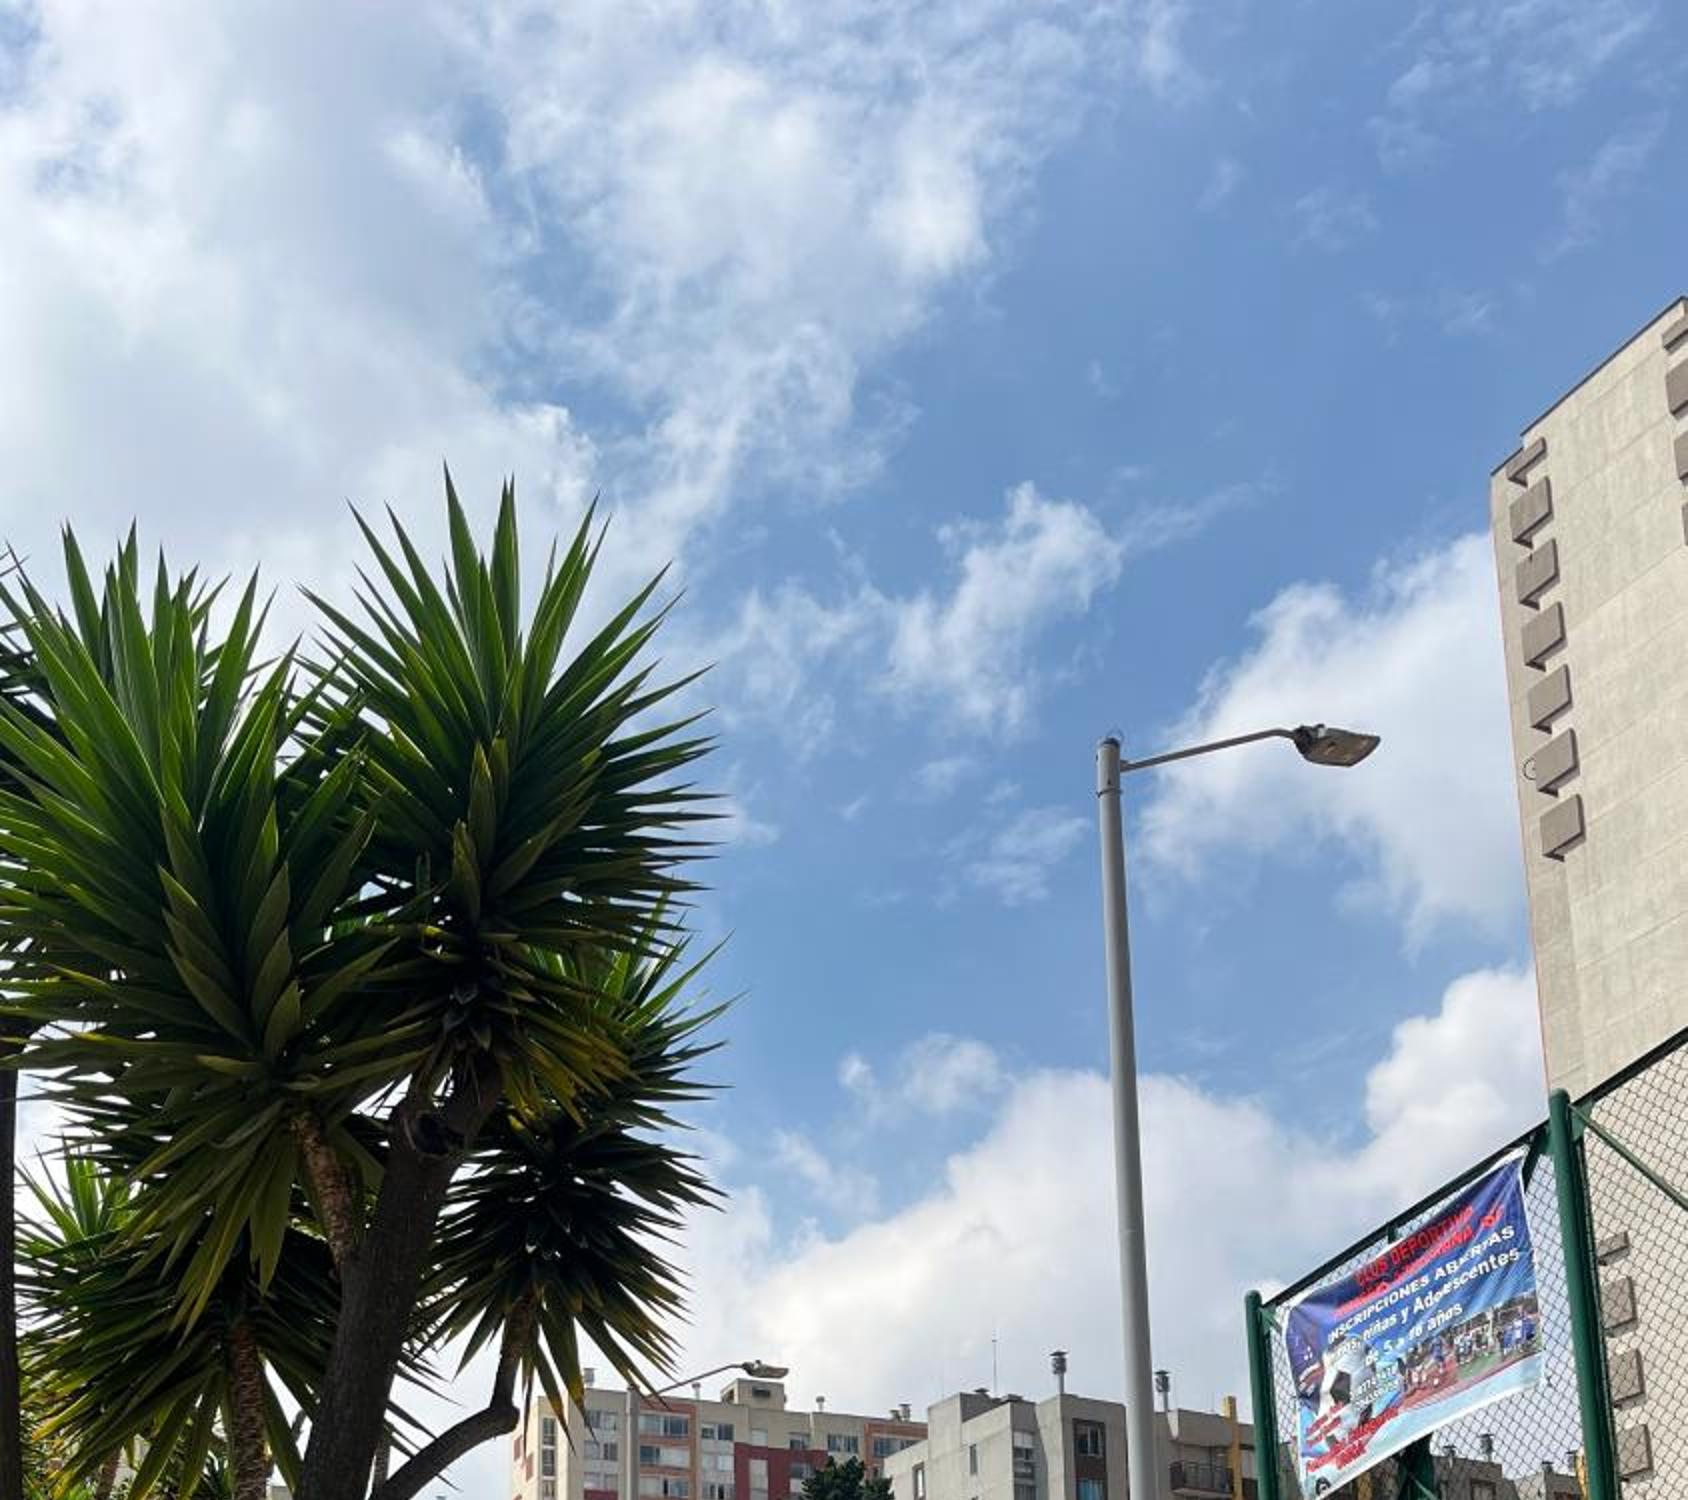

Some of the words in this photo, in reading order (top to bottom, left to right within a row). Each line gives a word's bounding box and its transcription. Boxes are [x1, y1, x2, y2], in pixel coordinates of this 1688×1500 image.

[1328, 1275, 1430, 1344] INSCRIPCIONES
[1383, 1339, 1394, 1353] 5
[1426, 1303, 1463, 1331] años
[1400, 1307, 1410, 1324] y
